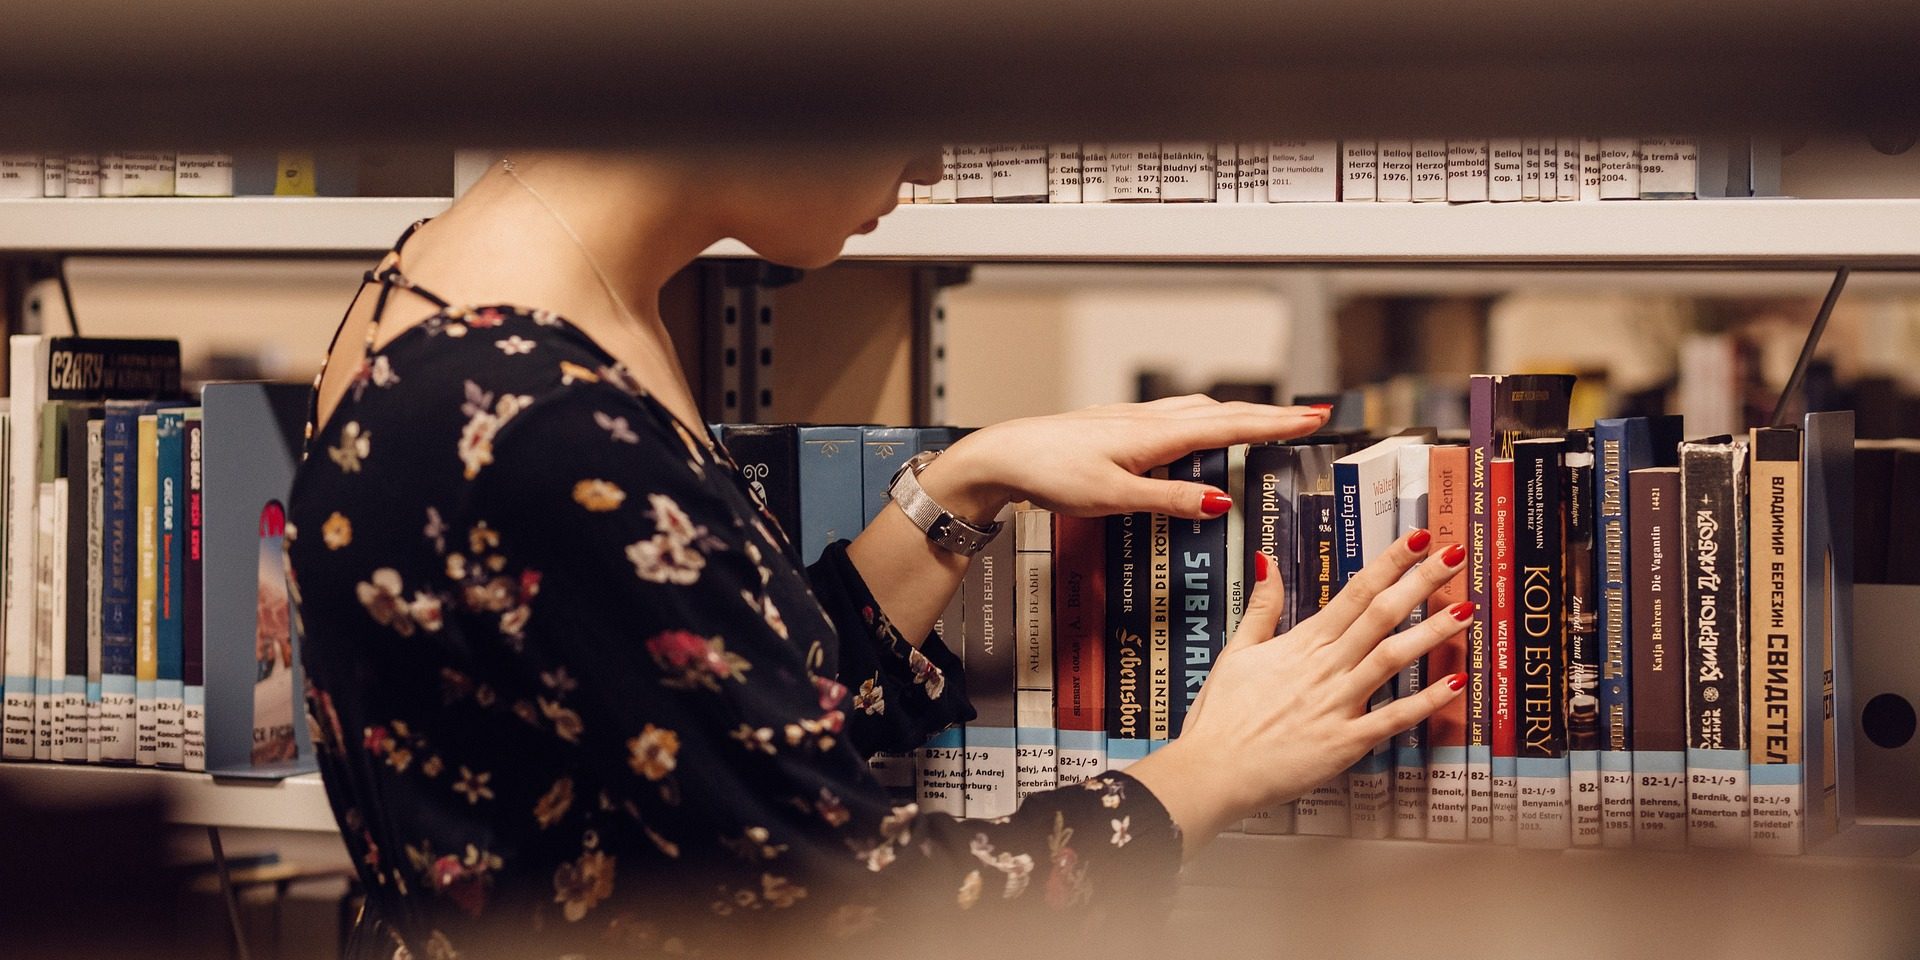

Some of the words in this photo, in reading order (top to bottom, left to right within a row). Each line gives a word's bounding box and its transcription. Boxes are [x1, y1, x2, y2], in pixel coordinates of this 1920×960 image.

[956, 161, 983, 169] Szosa
[1163, 153, 1205, 161] Belânkin,
[1602, 151, 1628, 159] Belov,
[1164, 165, 1197, 173] Bludnyj
[1383, 173, 1409, 181] 1976.
[1417, 173, 1443, 181] 1976.
[1494, 174, 1513, 182] cop.
[1601, 174, 1626, 182] 2004.
[51, 351, 103, 389] CZARY
[1472, 446, 1485, 489] ŚWIATA
[1535, 458, 1544, 500] BERNARD
[1571, 467, 1579, 483] idia
[1262, 473, 1279, 512] david
[1439, 469, 1454, 515] Benoit
[1474, 491, 1485, 515] PAN
[1497, 496, 1507, 508] G.
[1527, 479, 1535, 506] YOHAN
[1652, 488, 1661, 511] 14421
[1342, 484, 1357, 558] Benjamin
[1527, 508, 1535, 531] PEREZ
[1535, 503, 1544, 549] BENYAMIN
[1771, 476, 1784, 556] ВЛАДИМИР
[1319, 524, 1332, 533] 936
[1439, 524, 1454, 537] P.
[1496, 510, 1507, 560] Benusiglio,
[1320, 541, 1330, 553] VI
[1473, 520, 1484, 594] ANTYCHRYST
[1652, 525, 1663, 571] Vagantin
[982, 556, 993, 600] БЕЛЫЙ
[1155, 562, 1167, 590] DER
[1319, 555, 1330, 582] Band
[1498, 562, 1507, 572] R.
[1123, 563, 1133, 614] BENDER
[1495, 575, 1507, 608] Agasso
[1652, 575, 1662, 592] Die
[1771, 562, 1784, 628] БЕРЕЗИН
[1232, 580, 1241, 615] GŁĘBIA
[1524, 565, 1551, 638] KOD
[1155, 596, 1167, 623] BIN
[1572, 595, 1583, 632] Zawód:
[1652, 599, 1662, 641] Behrens
[982, 603, 994, 656] АНДРЕЙ
[1155, 629, 1167, 651] ICH
[1184, 551, 1211, 711] SUBMAR
[1472, 620, 1484, 669] BENSON
[1496, 619, 1508, 670] WZIĘŁAM
[1573, 635, 1584, 660] żona
[1652, 643, 1663, 671] Katja
[1073, 677, 1081, 717] SREBRNY
[1155, 668, 1166, 732] BELZNER
[1472, 672, 1483, 719] HUGON
[1524, 646, 1552, 756] ESTERY
[923, 768, 948, 778] Belyj,
[976, 768, 1005, 778] Andrej
[1060, 757, 1098, 767] 82-1/-9
[1060, 774, 1082, 783] Belyj,
[1692, 775, 1736, 785] 82-1/-9
[923, 791, 947, 799] 1994.
[1431, 788, 1464, 798] Benoit,
[1522, 787, 1556, 796] 82-1/-9
[1640, 798, 1680, 807] Behrens,
[1691, 793, 1731, 802] Berdnik,
[1753, 796, 1790, 805] 82-1/-9
[1431, 815, 1457, 823] 1981.
[1471, 804, 1488, 812] Pan
[1522, 812, 1538, 820] Kod
[1691, 808, 1737, 817] Kamerton
[1753, 808, 1791, 816] Berezin,
[1605, 821, 1631, 829] 1985.
[1691, 820, 1717, 828] 1996.
